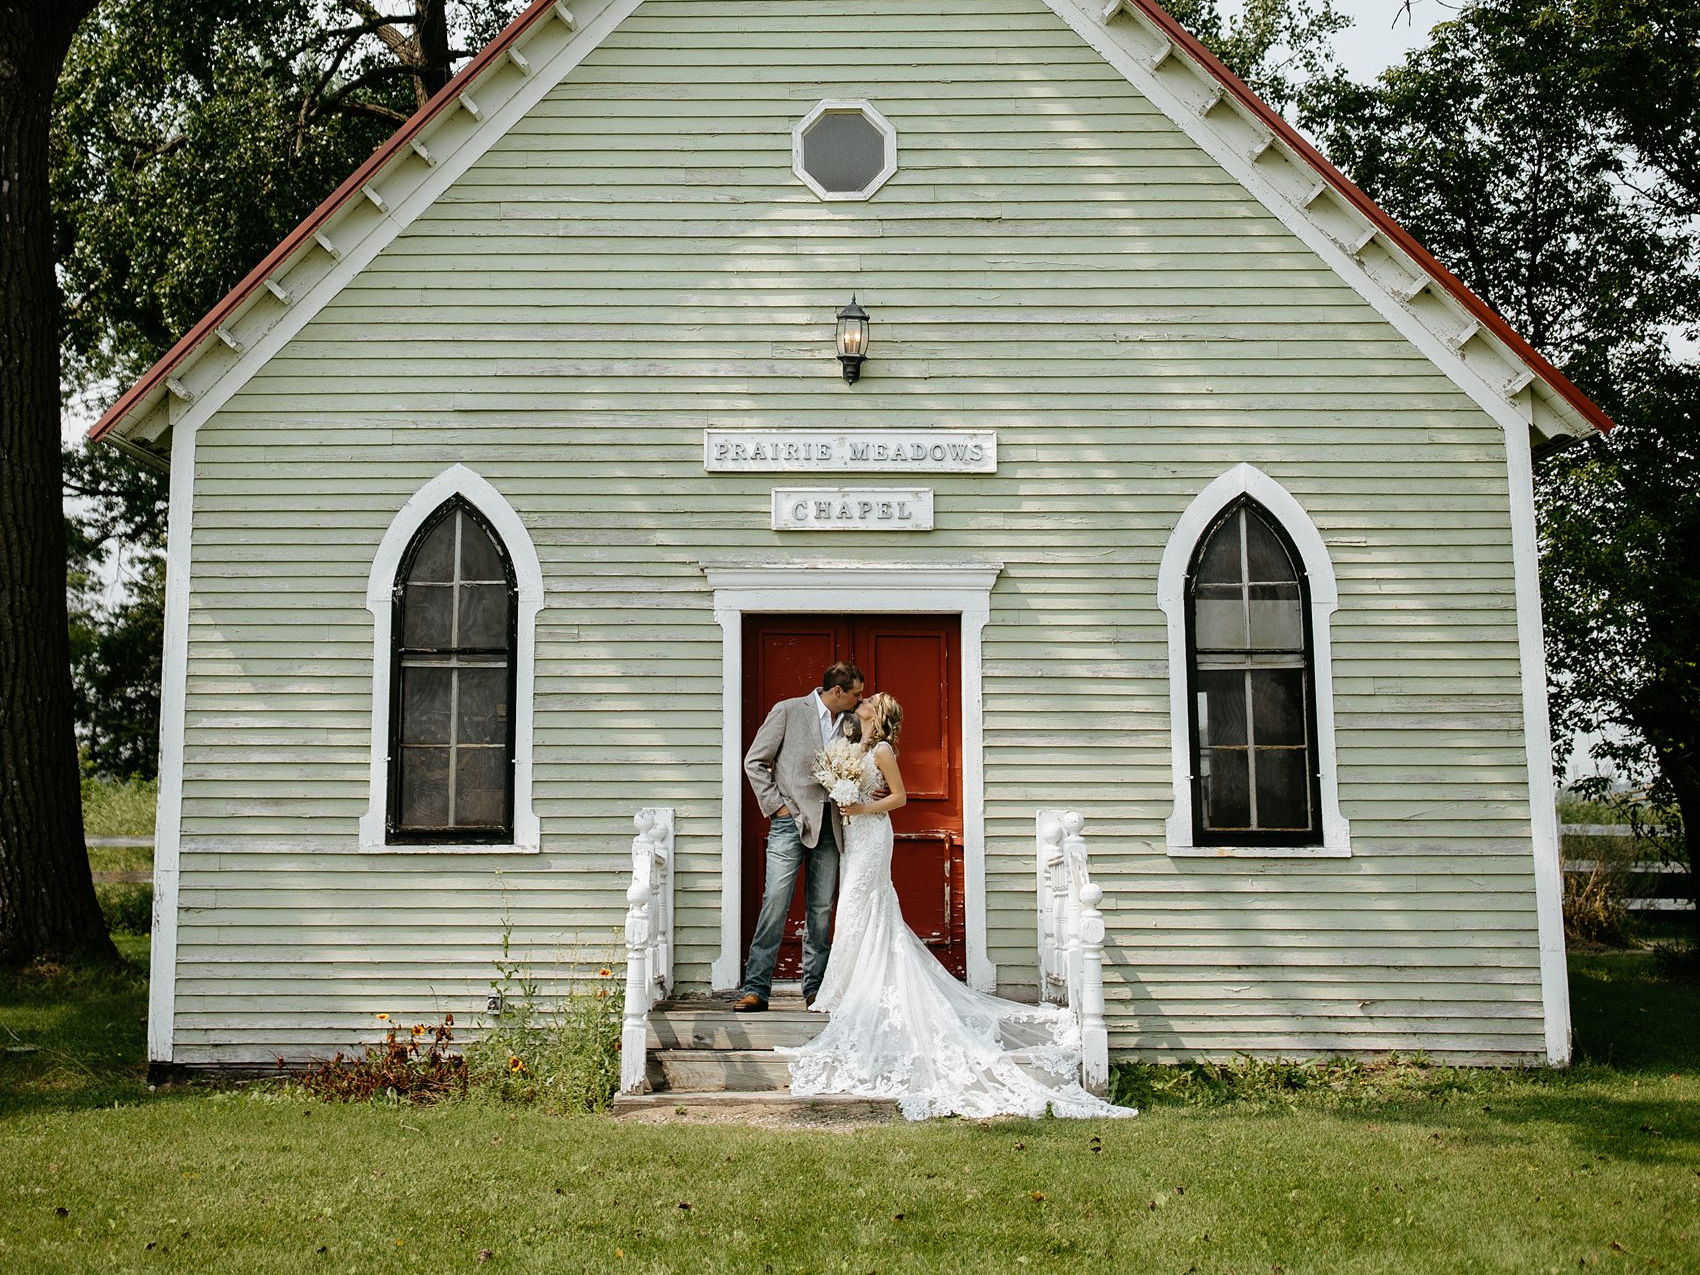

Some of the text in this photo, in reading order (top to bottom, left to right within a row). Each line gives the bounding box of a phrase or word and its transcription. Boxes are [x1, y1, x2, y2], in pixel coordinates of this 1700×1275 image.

[714, 442, 985, 462] PRAIRIE MEADOWS
[791, 500, 912, 521] CHAPEL
